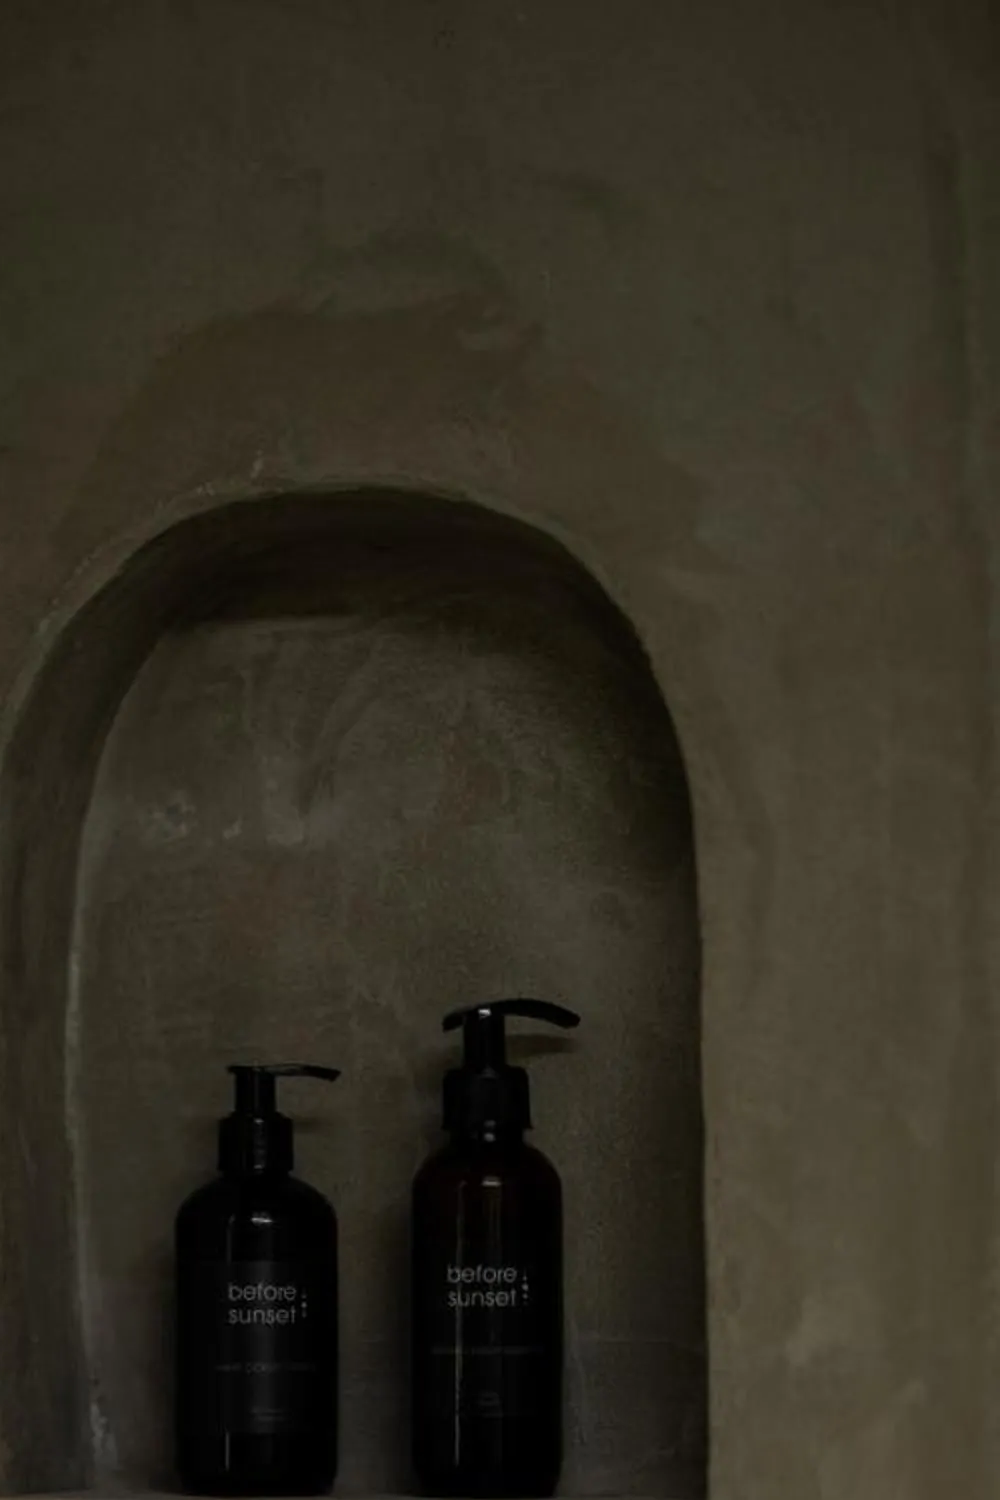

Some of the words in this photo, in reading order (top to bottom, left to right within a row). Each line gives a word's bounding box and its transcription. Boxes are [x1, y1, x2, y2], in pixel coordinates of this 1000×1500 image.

[446, 1264, 517, 1284] before
[227, 1281, 297, 1302] before
[446, 1287, 517, 1307] sunset
[227, 1304, 296, 1325] sunset
